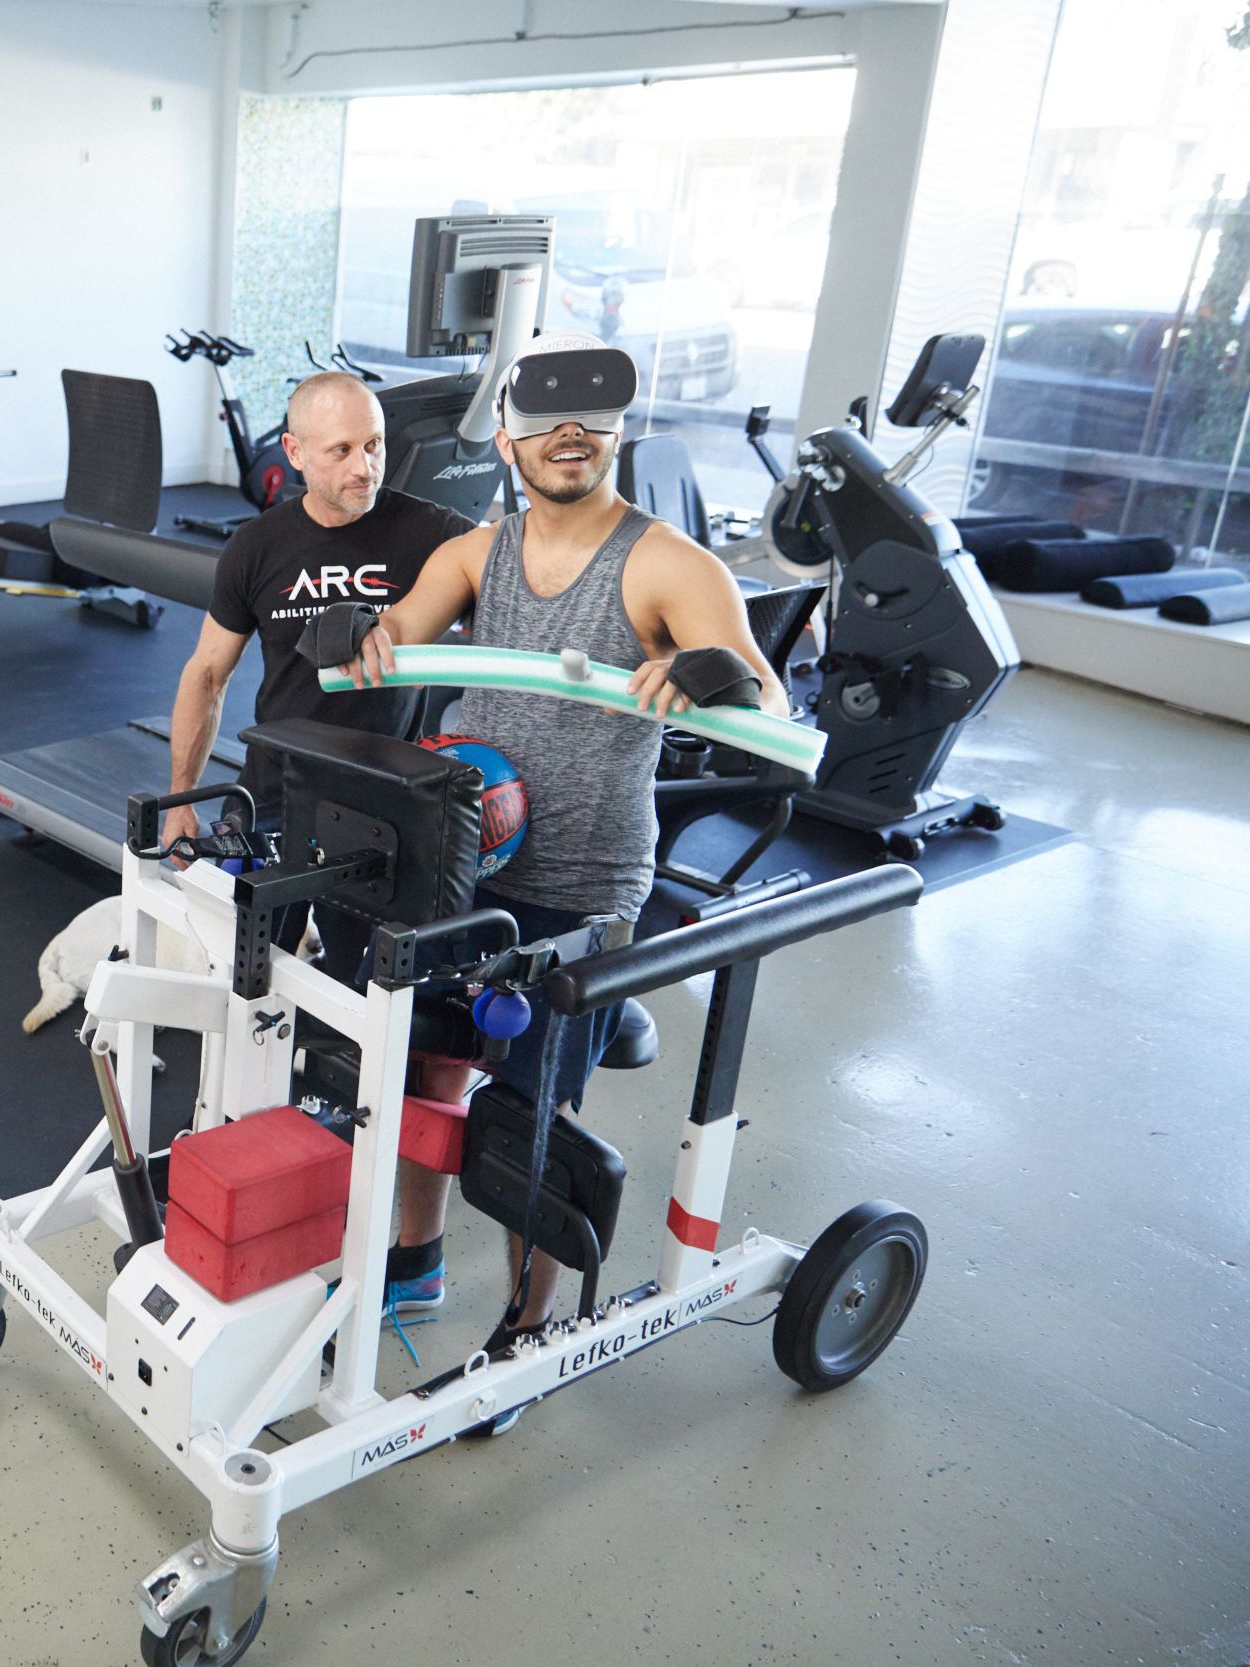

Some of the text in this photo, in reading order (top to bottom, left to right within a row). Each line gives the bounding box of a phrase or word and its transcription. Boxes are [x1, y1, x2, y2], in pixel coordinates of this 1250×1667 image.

[288, 564, 389, 601] ARC
[271, 605, 331, 620] ABILITIE
[0, 1260, 56, 1329] Lefko-tek
[559, 1308, 678, 1378] Lefko-tek
